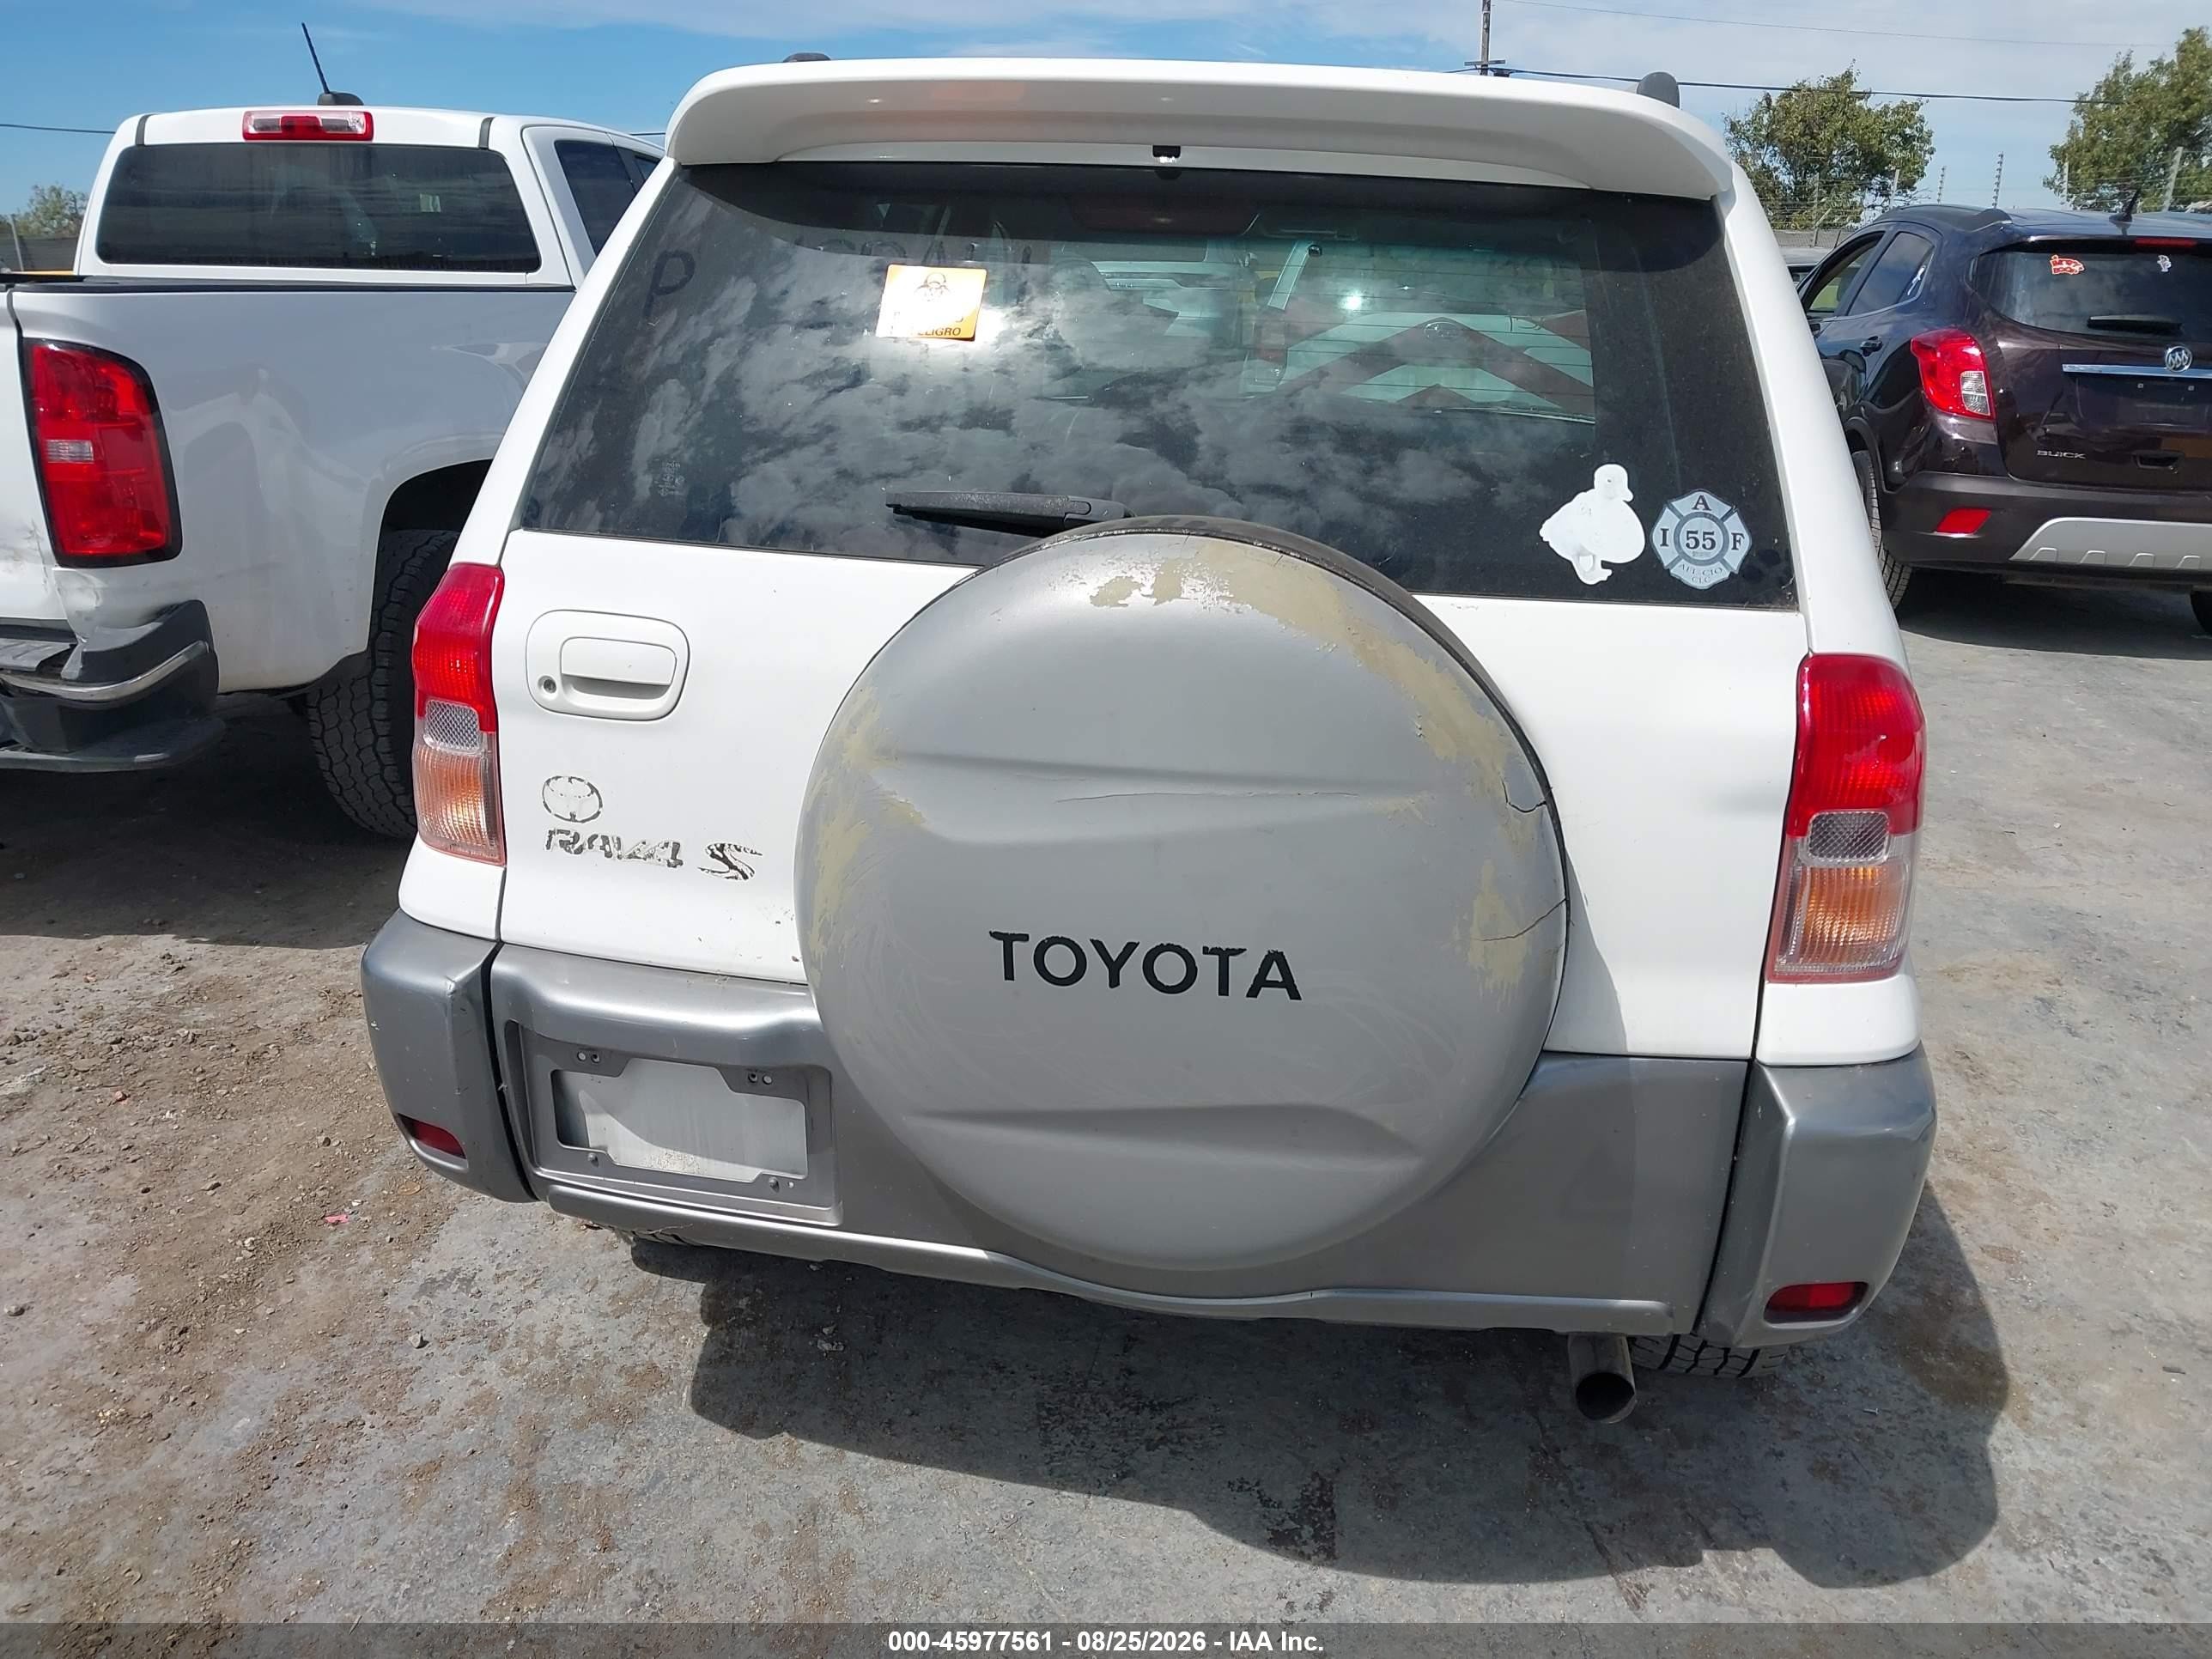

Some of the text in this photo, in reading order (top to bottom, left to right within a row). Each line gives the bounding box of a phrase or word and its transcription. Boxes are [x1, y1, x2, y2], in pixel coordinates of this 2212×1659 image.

[2037, 449, 2087, 460] BUICK
[1692, 495, 1711, 511] A
[1660, 528, 1745, 550] I 55 F
[988, 929, 1303, 1001] TOYOTA
